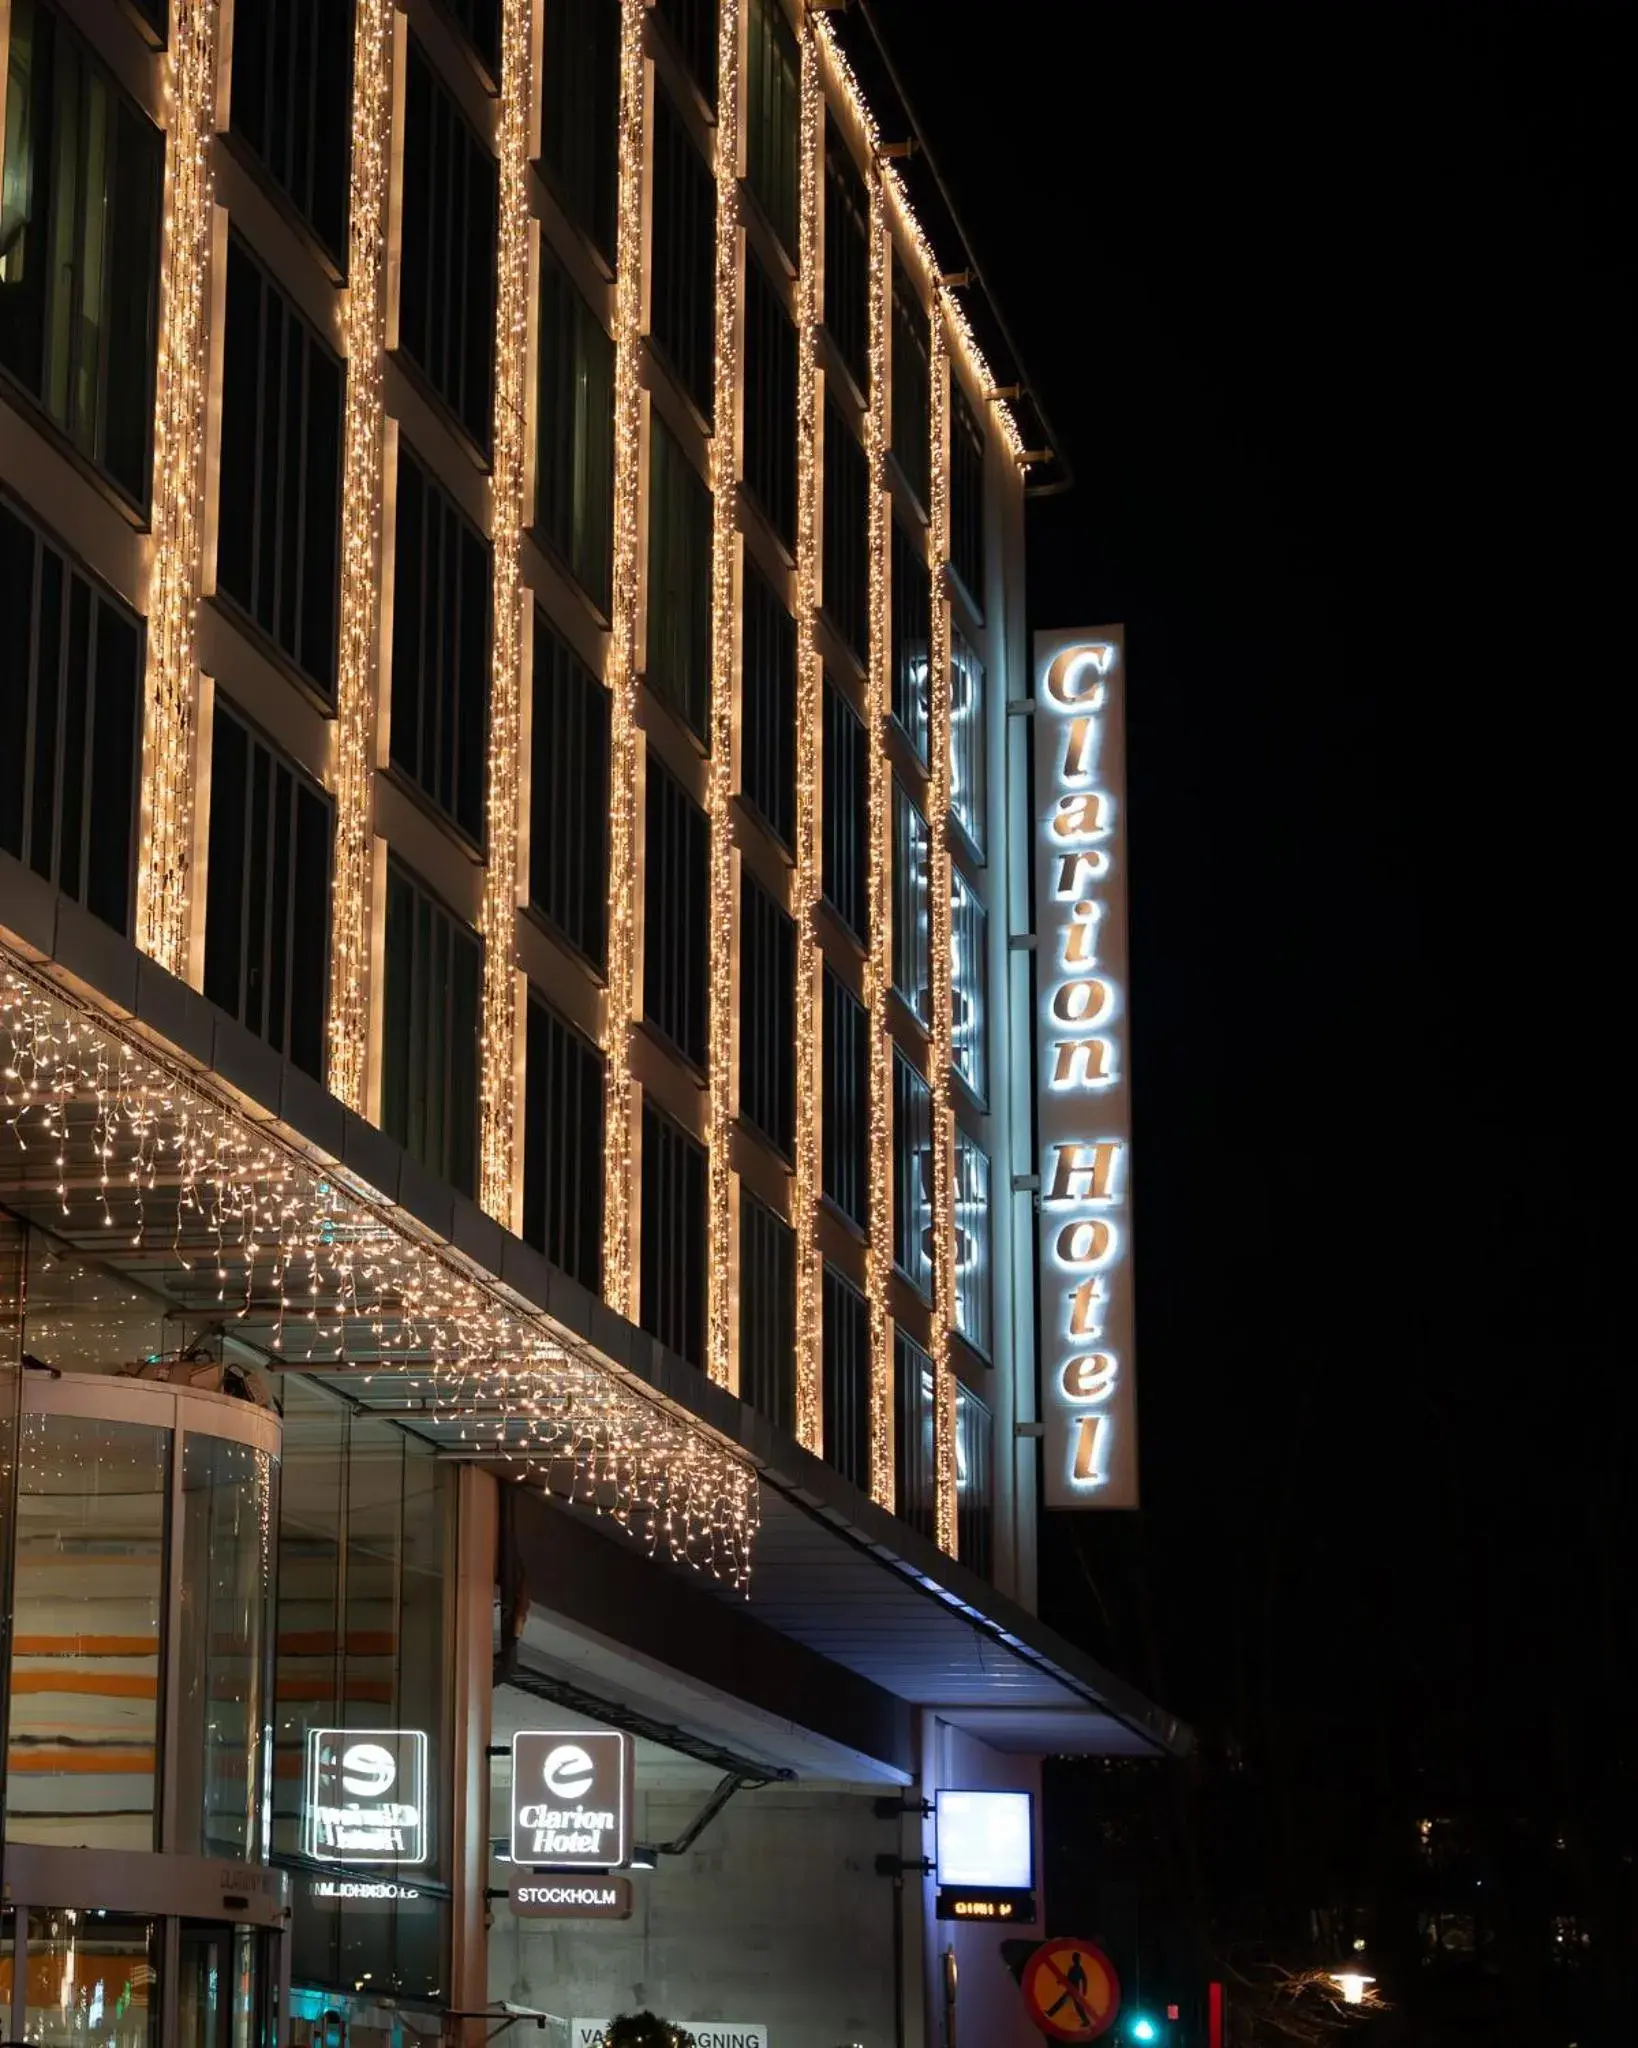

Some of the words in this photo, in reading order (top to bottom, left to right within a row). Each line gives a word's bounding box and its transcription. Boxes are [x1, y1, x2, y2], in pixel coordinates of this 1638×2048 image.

[1045, 643, 1112, 1085] Clarion
[1043, 1141, 1124, 1483] Hotel
[519, 1804, 614, 1829] Clarion
[532, 1829, 600, 1853] Hotel
[518, 1888, 616, 1905] STOCKHOLM
